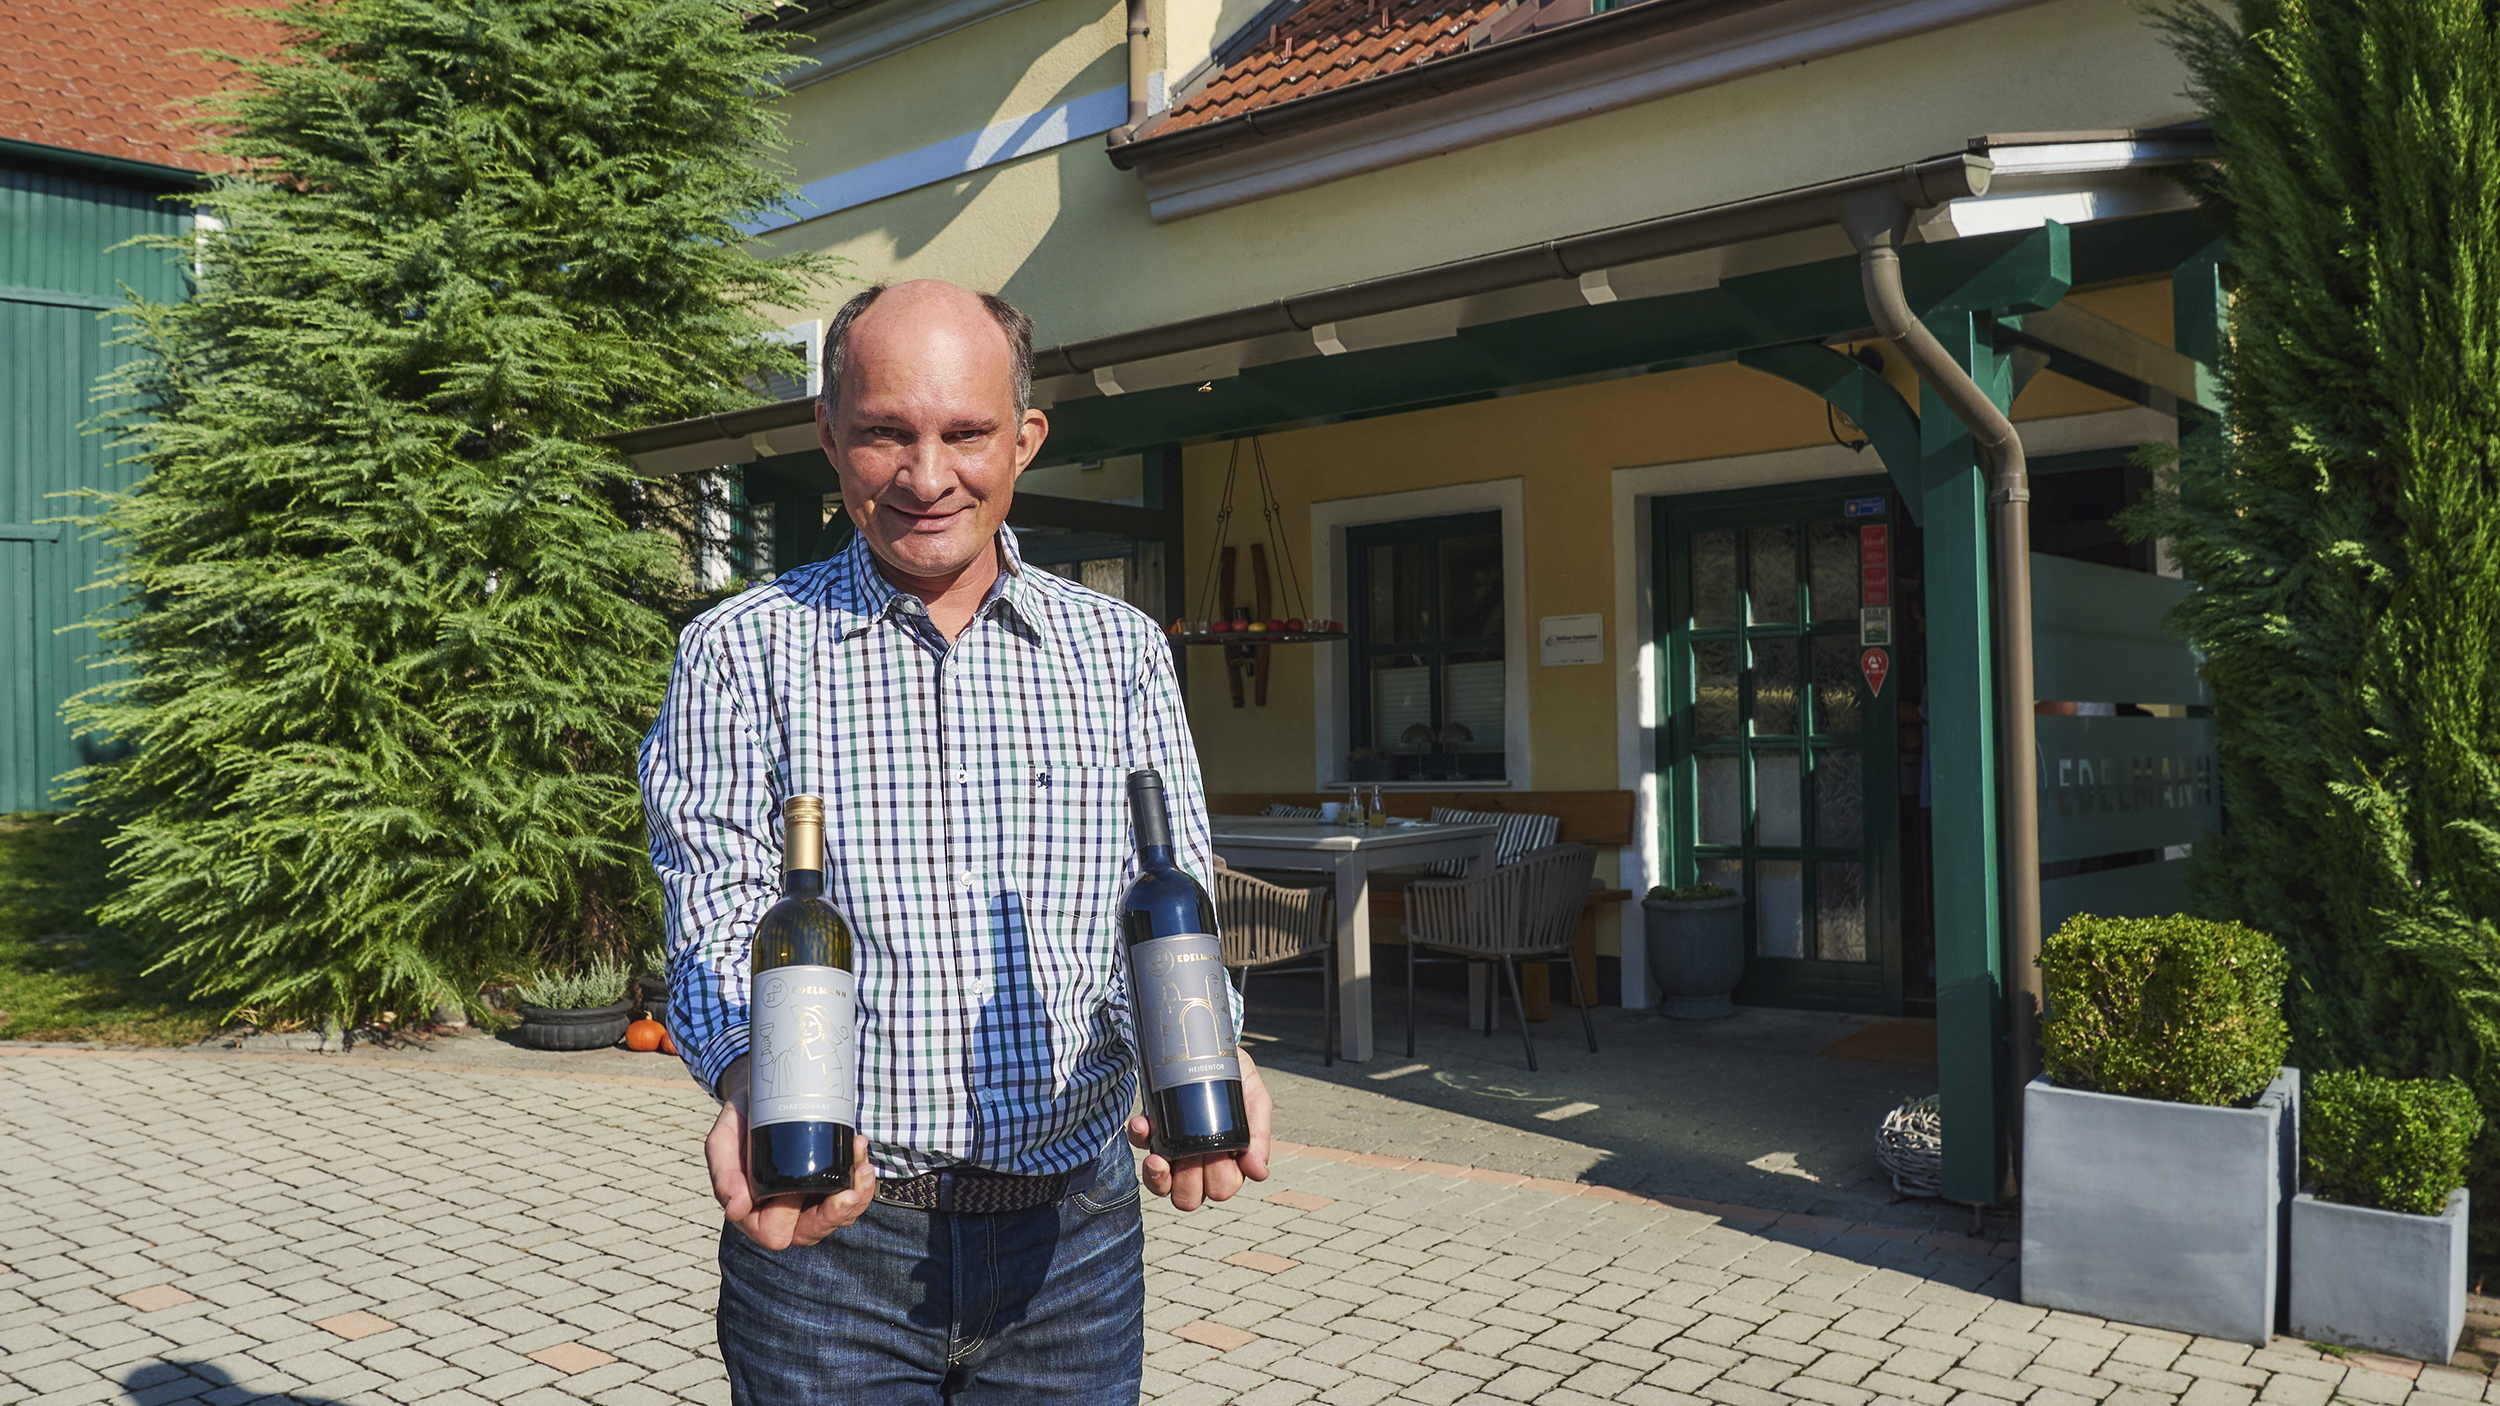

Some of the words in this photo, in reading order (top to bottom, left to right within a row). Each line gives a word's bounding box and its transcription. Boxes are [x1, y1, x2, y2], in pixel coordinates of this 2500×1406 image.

[792, 986, 847, 998] EDELMANN
[1188, 1063, 1225, 1073] HEIDENTOR
[778, 1103, 831, 1112] CHARDONNAY
